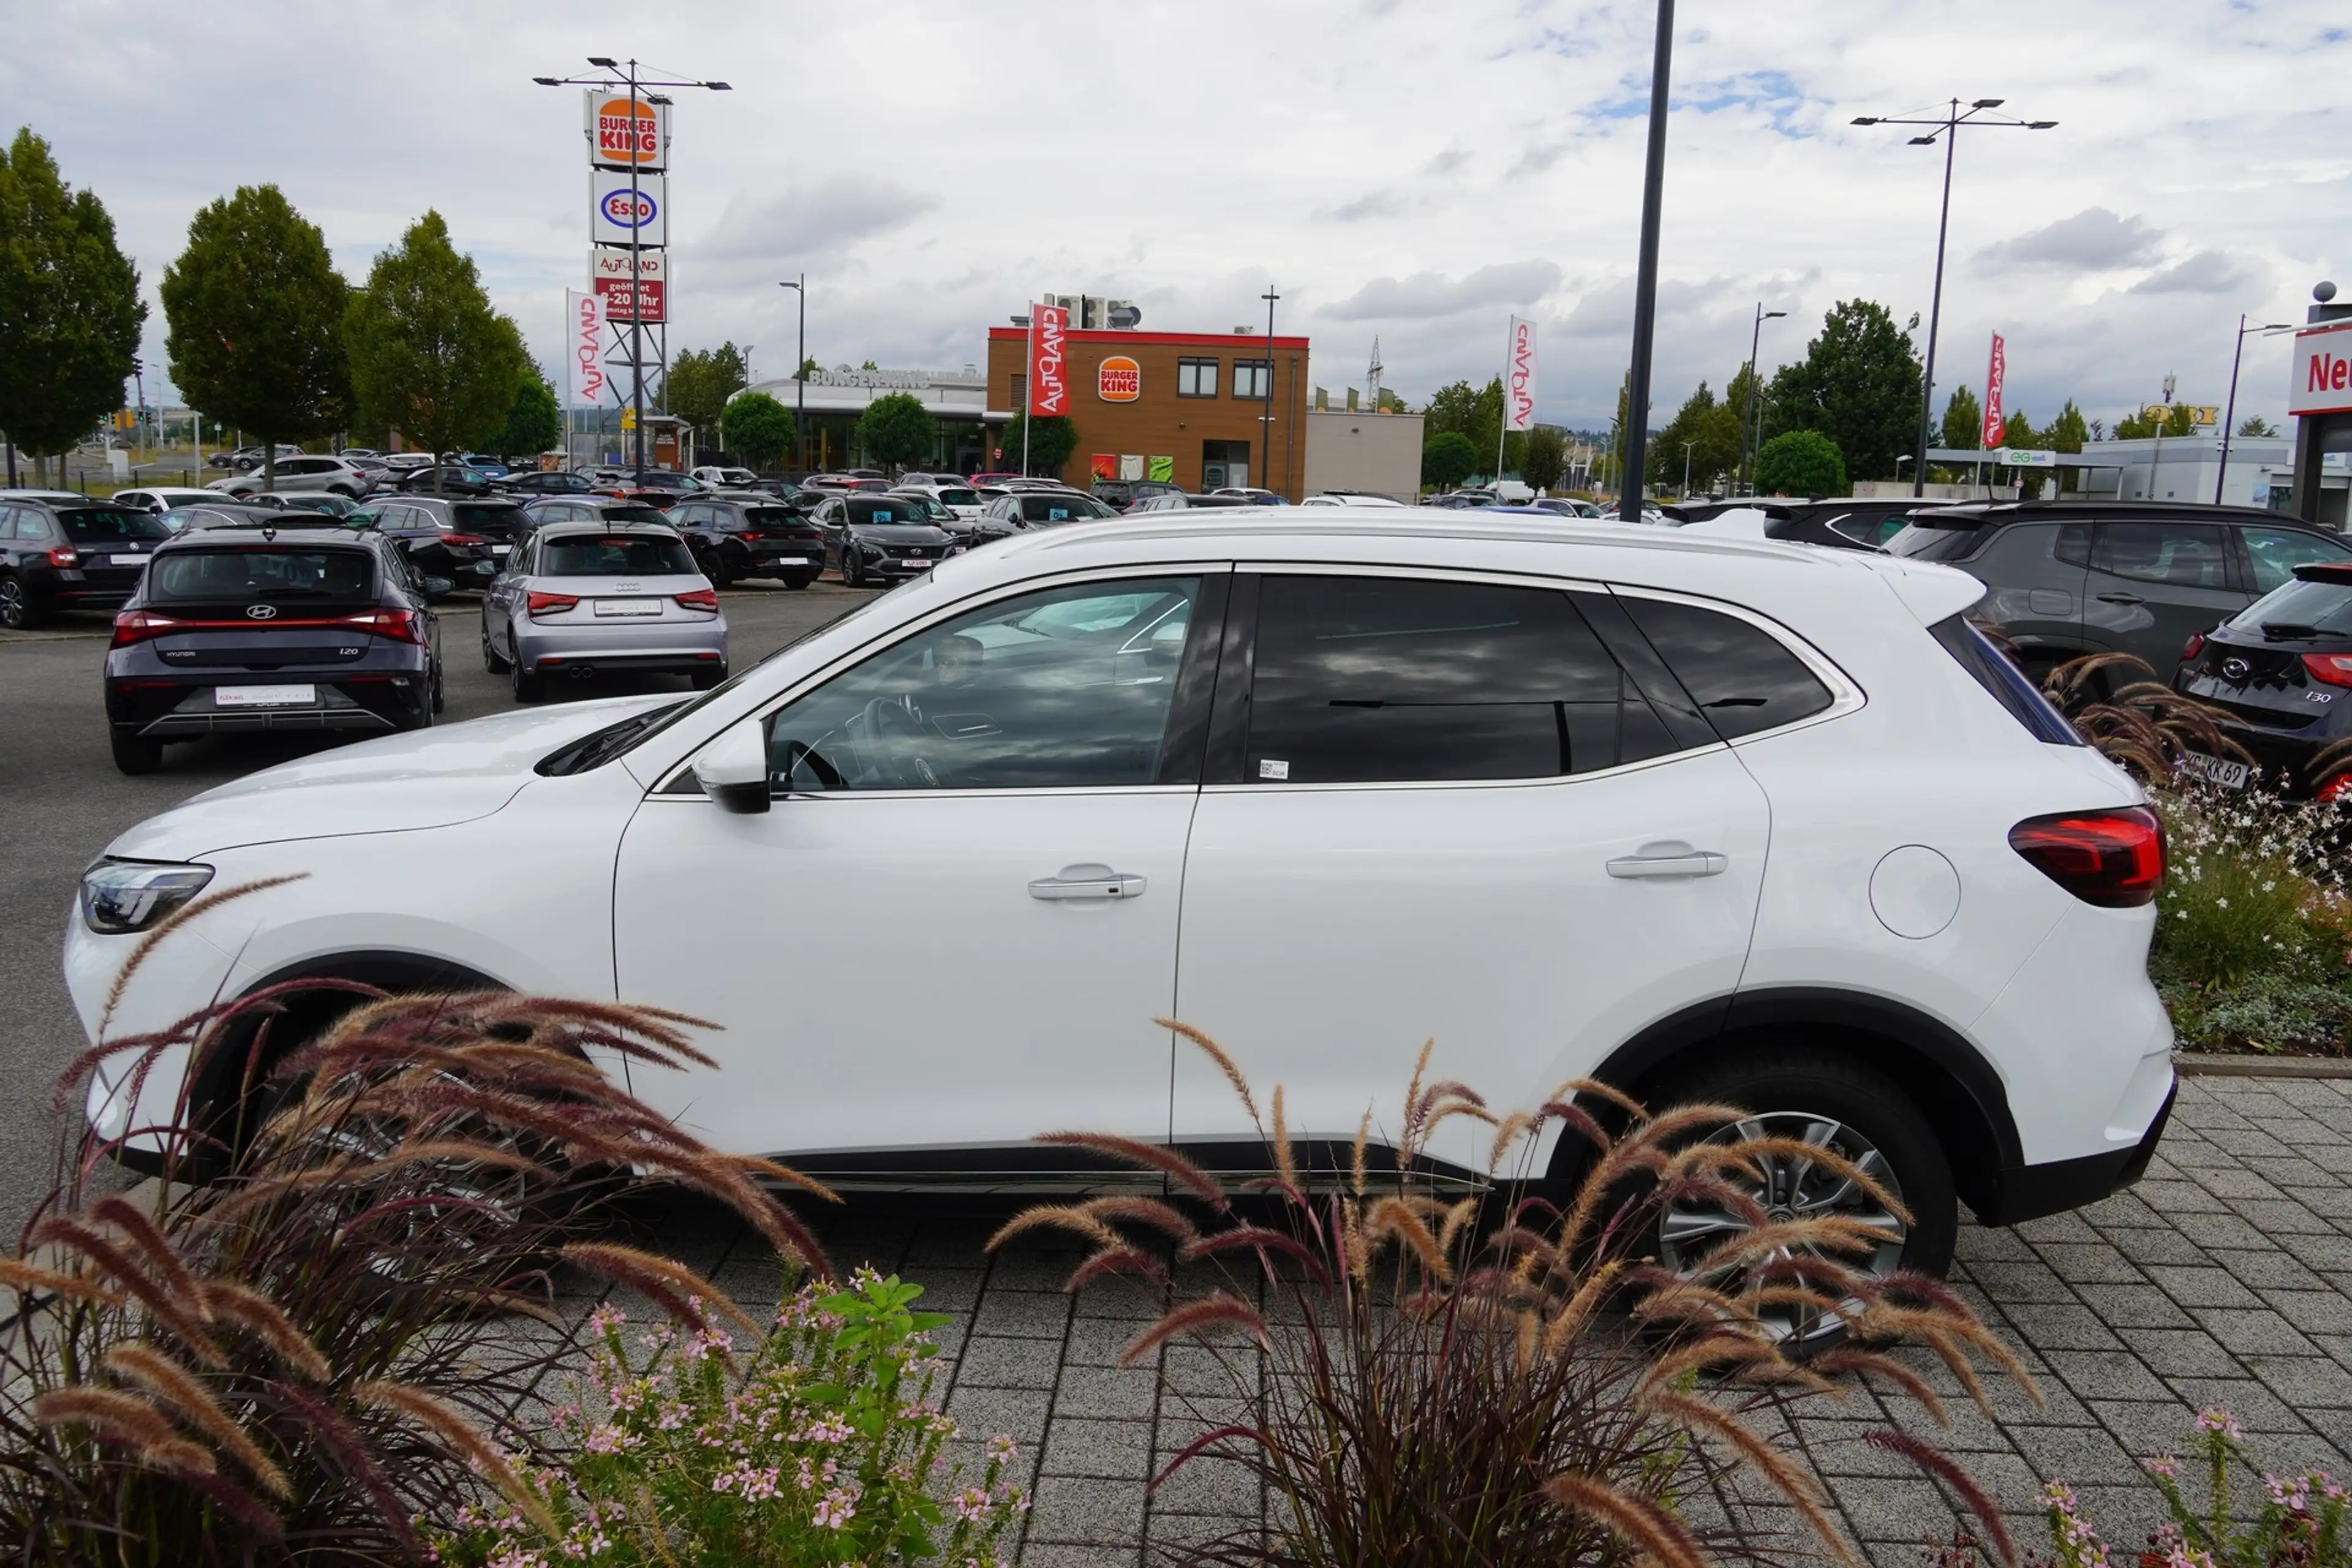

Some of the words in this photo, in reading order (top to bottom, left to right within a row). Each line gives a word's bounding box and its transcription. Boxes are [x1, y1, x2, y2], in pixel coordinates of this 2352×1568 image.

[600, 117, 657, 133] BURGER
[600, 130, 657, 152] KING
[609, 282, 650, 292] geöffet
[578, 298, 603, 401] AUTOLAND
[1038, 308, 1064, 413] AUTOLAND
[1101, 371, 1138, 380] BURGER
[1511, 323, 1533, 427] AUTOLAND
[2308, 353, 2352, 393] Ne
[1101, 380, 1138, 393] KING
[2223, 764, 2242, 784] 69
